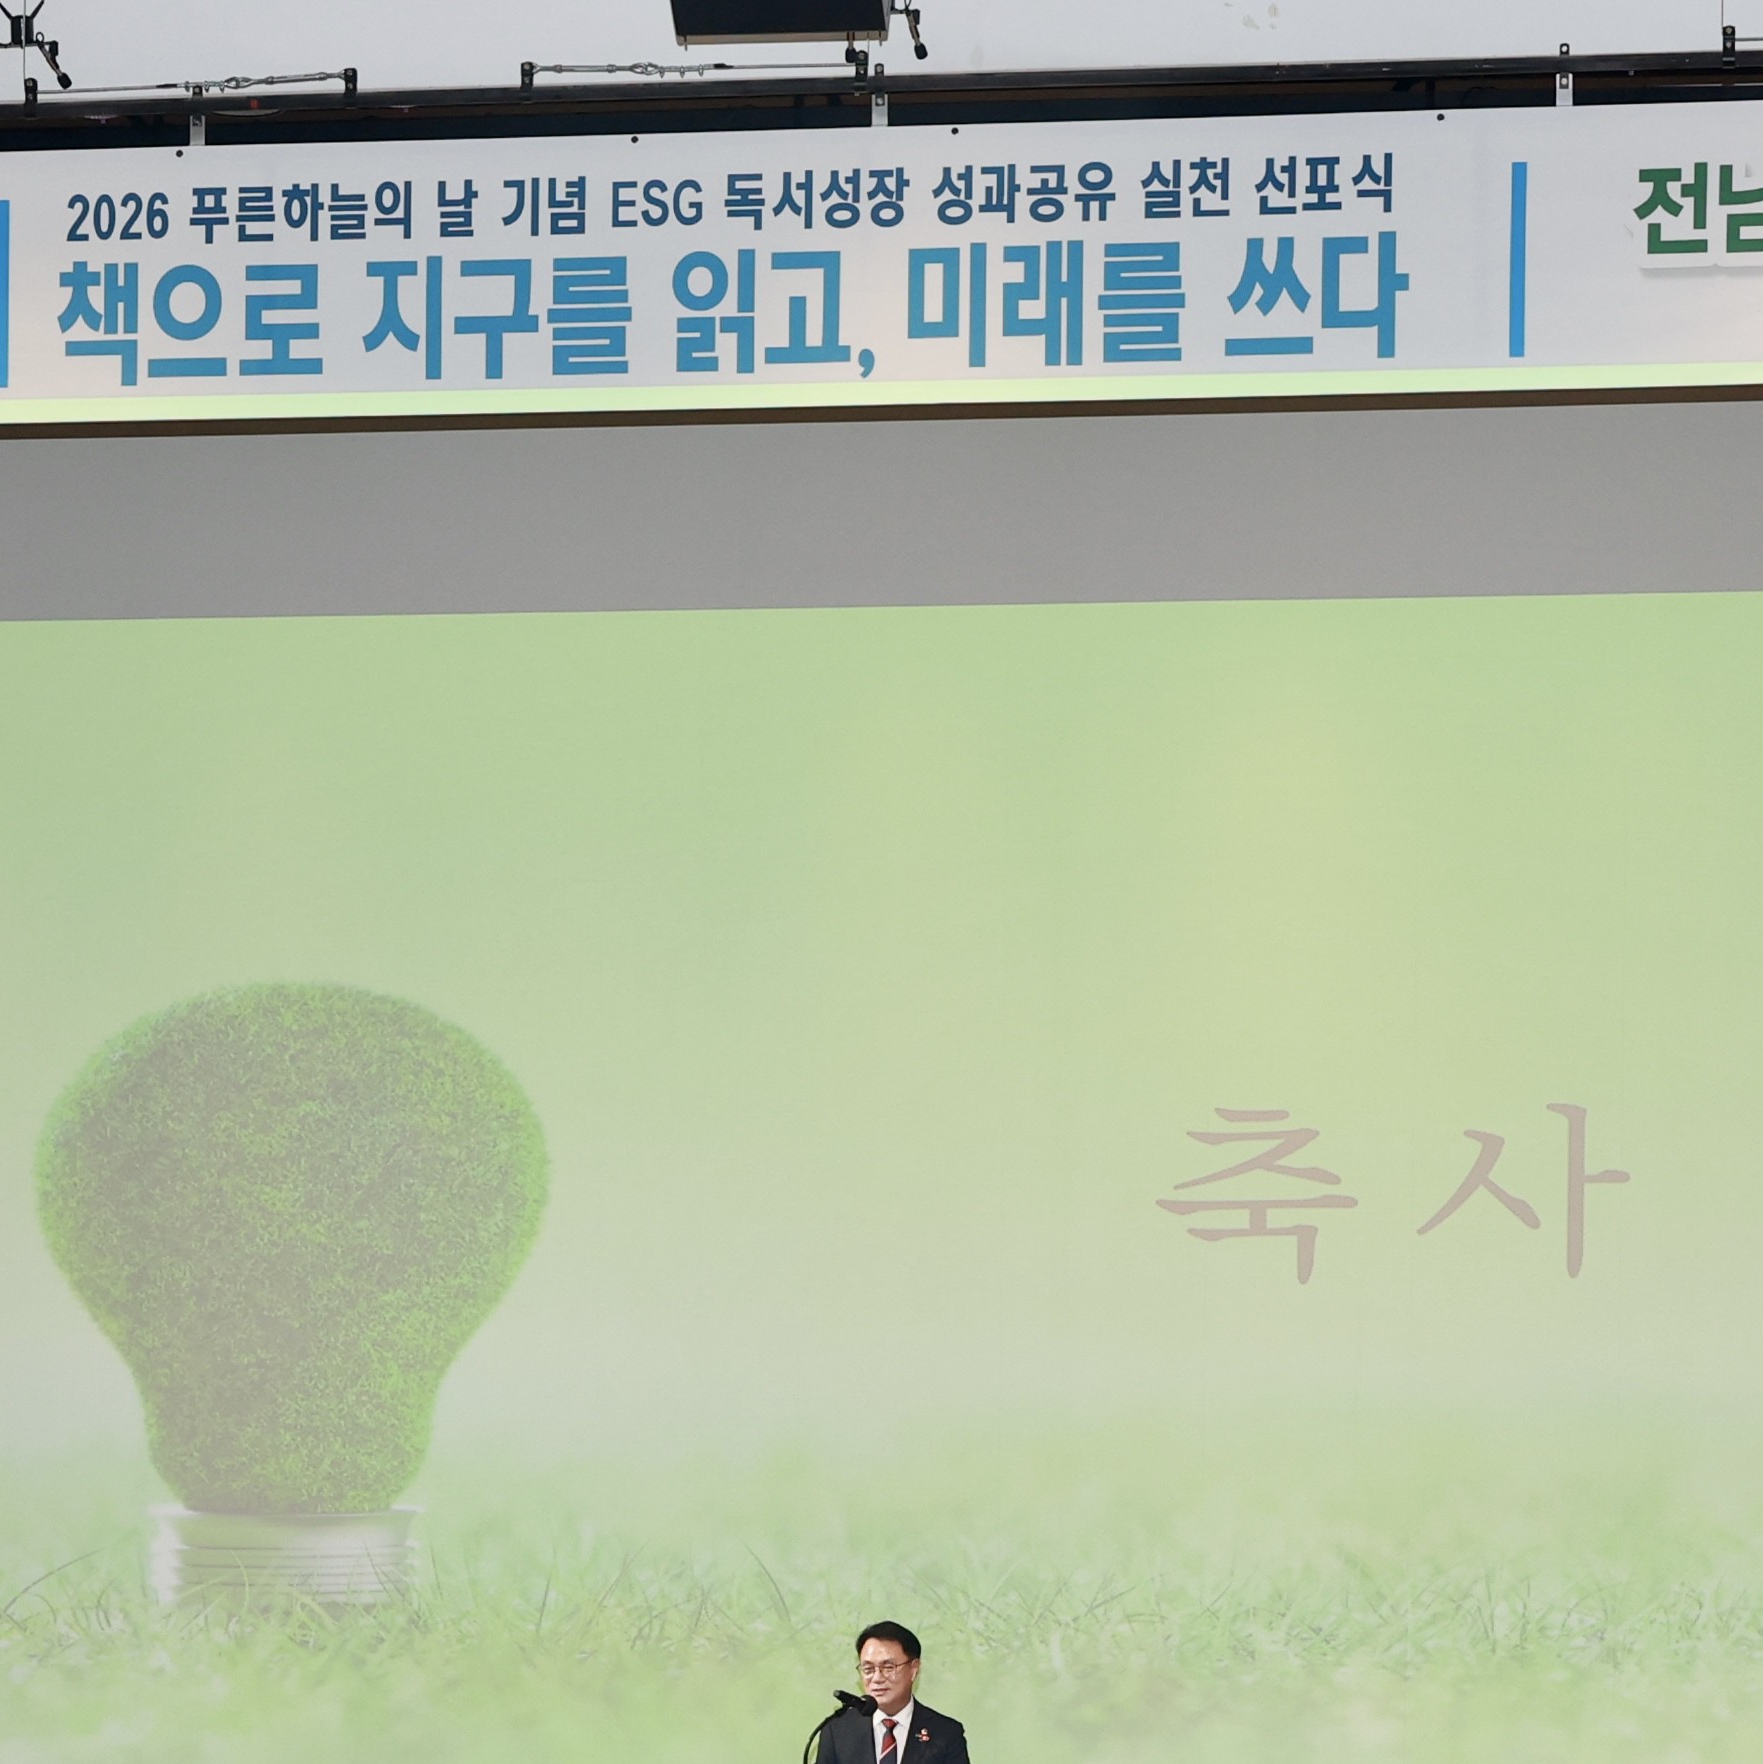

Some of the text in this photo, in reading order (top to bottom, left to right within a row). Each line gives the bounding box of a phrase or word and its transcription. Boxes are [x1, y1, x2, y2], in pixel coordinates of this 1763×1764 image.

[67, 153, 1393, 244] 2026 푸른하늘의 날 기념 ESG 독서성장 성과공유 실천 선포식
[58, 231, 1409, 386] 책으로 지구를 읽고, 미래를 쓰다
